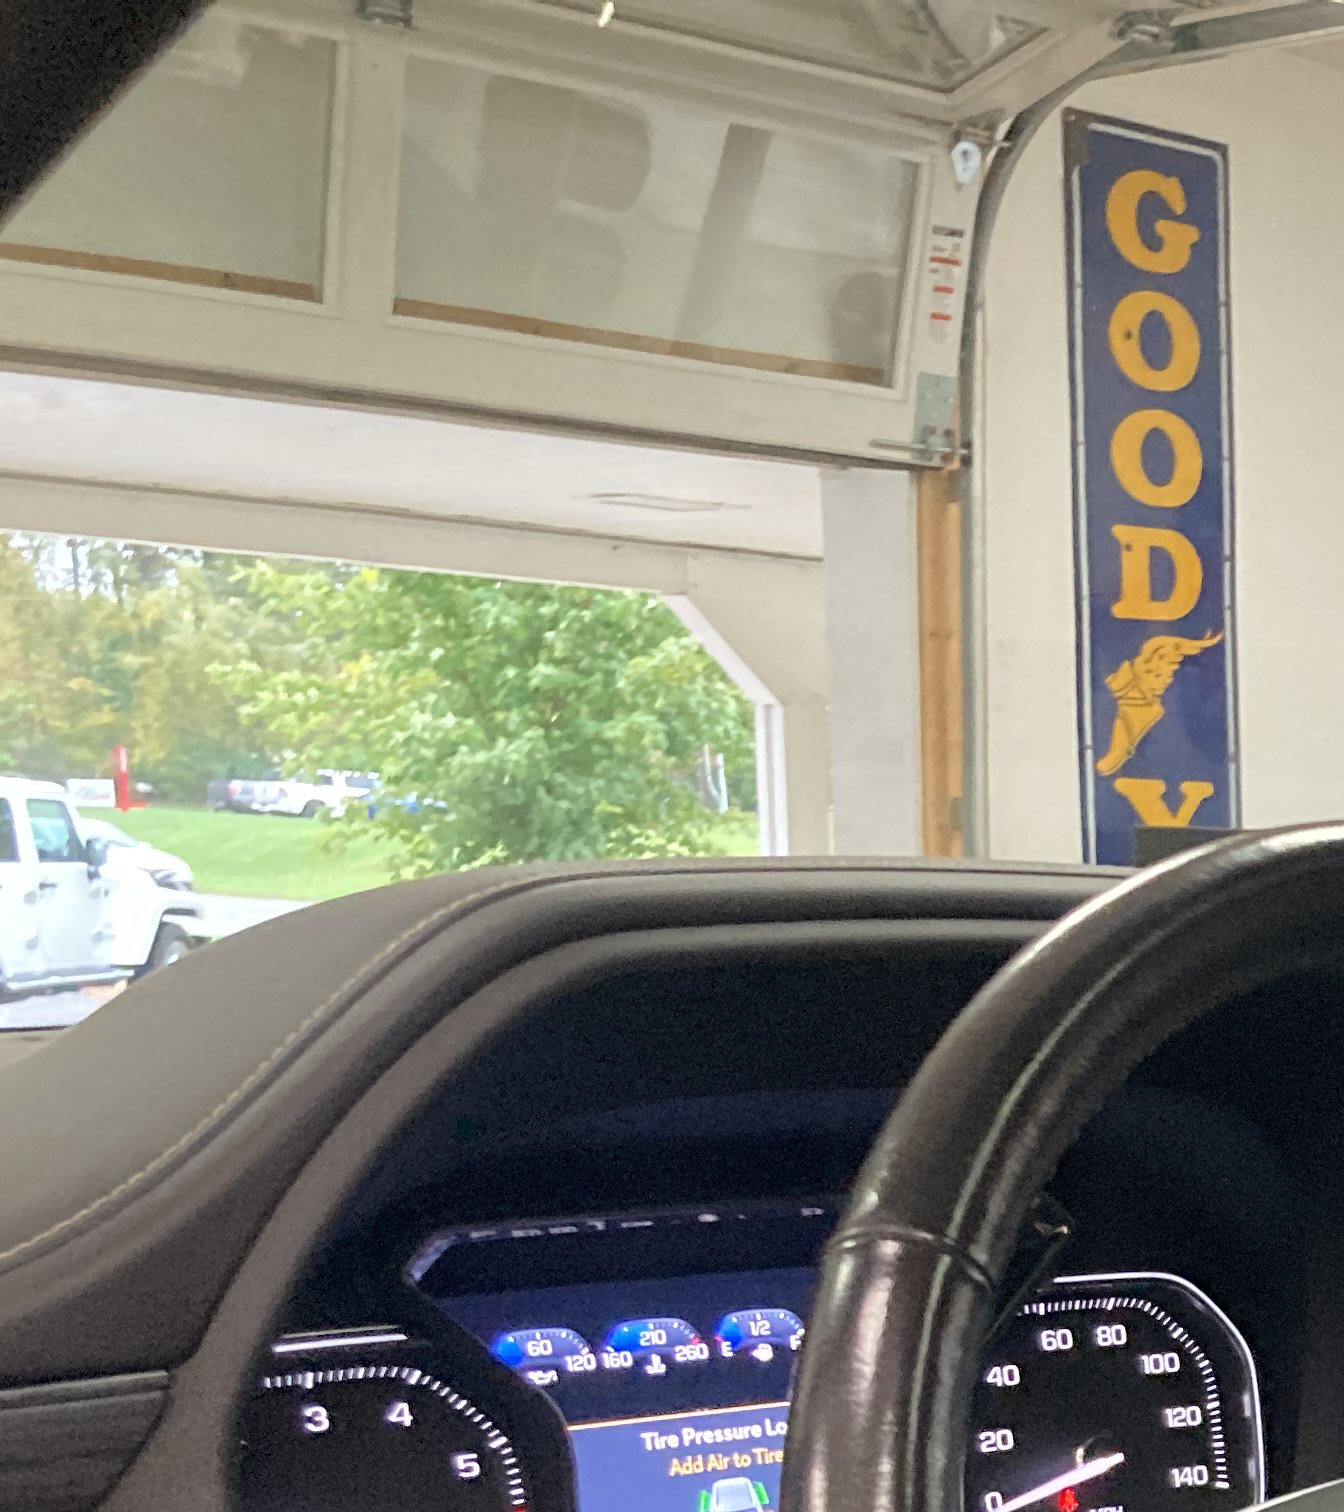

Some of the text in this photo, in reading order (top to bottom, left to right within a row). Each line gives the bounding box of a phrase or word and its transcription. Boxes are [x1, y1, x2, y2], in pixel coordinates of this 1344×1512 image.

[527, 1339, 552, 1357] 60
[639, 1329, 667, 1347] 210
[1041, 1328, 1074, 1352] 60
[1096, 1324, 1127, 1348] 80
[602, 1350, 633, 1369] 160
[674, 1342, 709, 1362] 260
[720, 1341, 734, 1359] E
[565, 1353, 597, 1373] 120
[1140, 1352, 1181, 1376] 100
[986, 1364, 1021, 1388] 40
[303, 1405, 330, 1433] 3
[387, 1402, 414, 1428] 4
[1165, 1406, 1202, 1429] 120
[640, 1431, 679, 1451] Tire
[682, 1423, 763, 1448] Pressure
[979, 1429, 1015, 1453] 20
[455, 1452, 480, 1479] 5
[668, 1458, 704, 1477] Add
[706, 1453, 731, 1471] Air
[734, 1452, 752, 1468] to
[1171, 1465, 1209, 1489] 140
